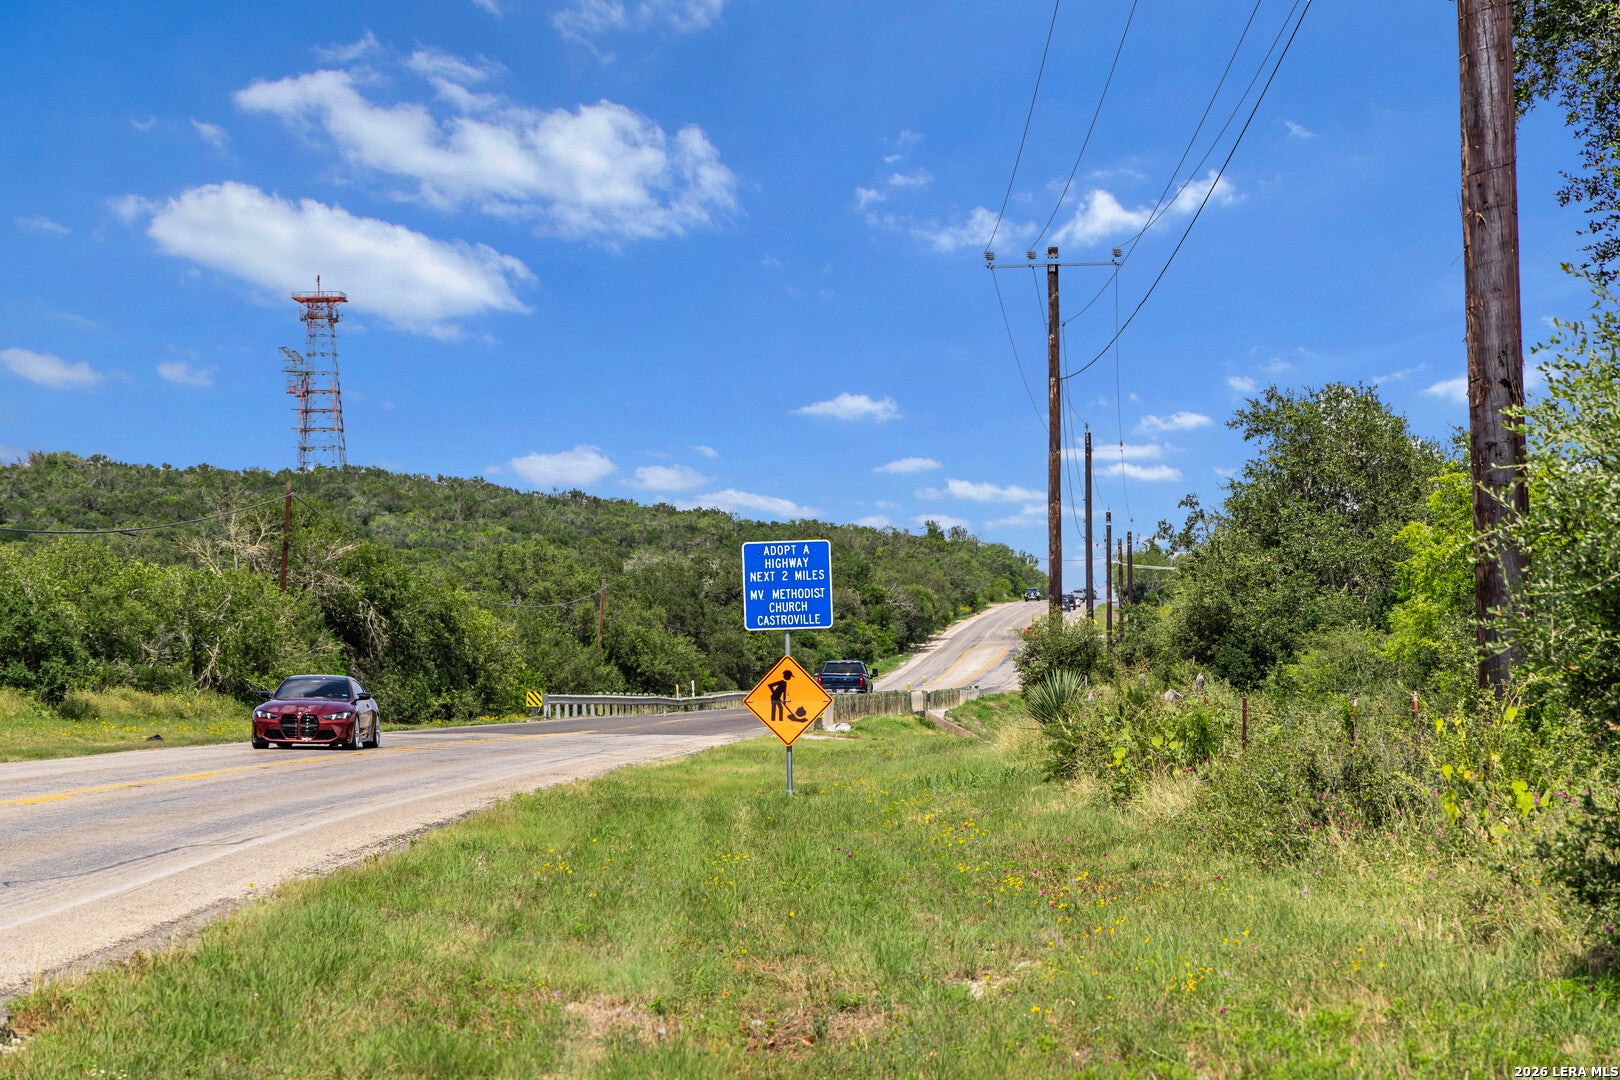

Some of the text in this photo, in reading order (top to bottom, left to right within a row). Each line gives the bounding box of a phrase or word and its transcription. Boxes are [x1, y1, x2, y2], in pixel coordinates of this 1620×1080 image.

[763, 544, 810, 556] ADOPT A
[764, 557, 808, 568] HIGHWAY
[750, 570, 825, 582] NEXT 2 MILES
[772, 587, 825, 600] METHODIST
[768, 601, 808, 612] CHURCH
[757, 613, 821, 626] CASTROVILLE
